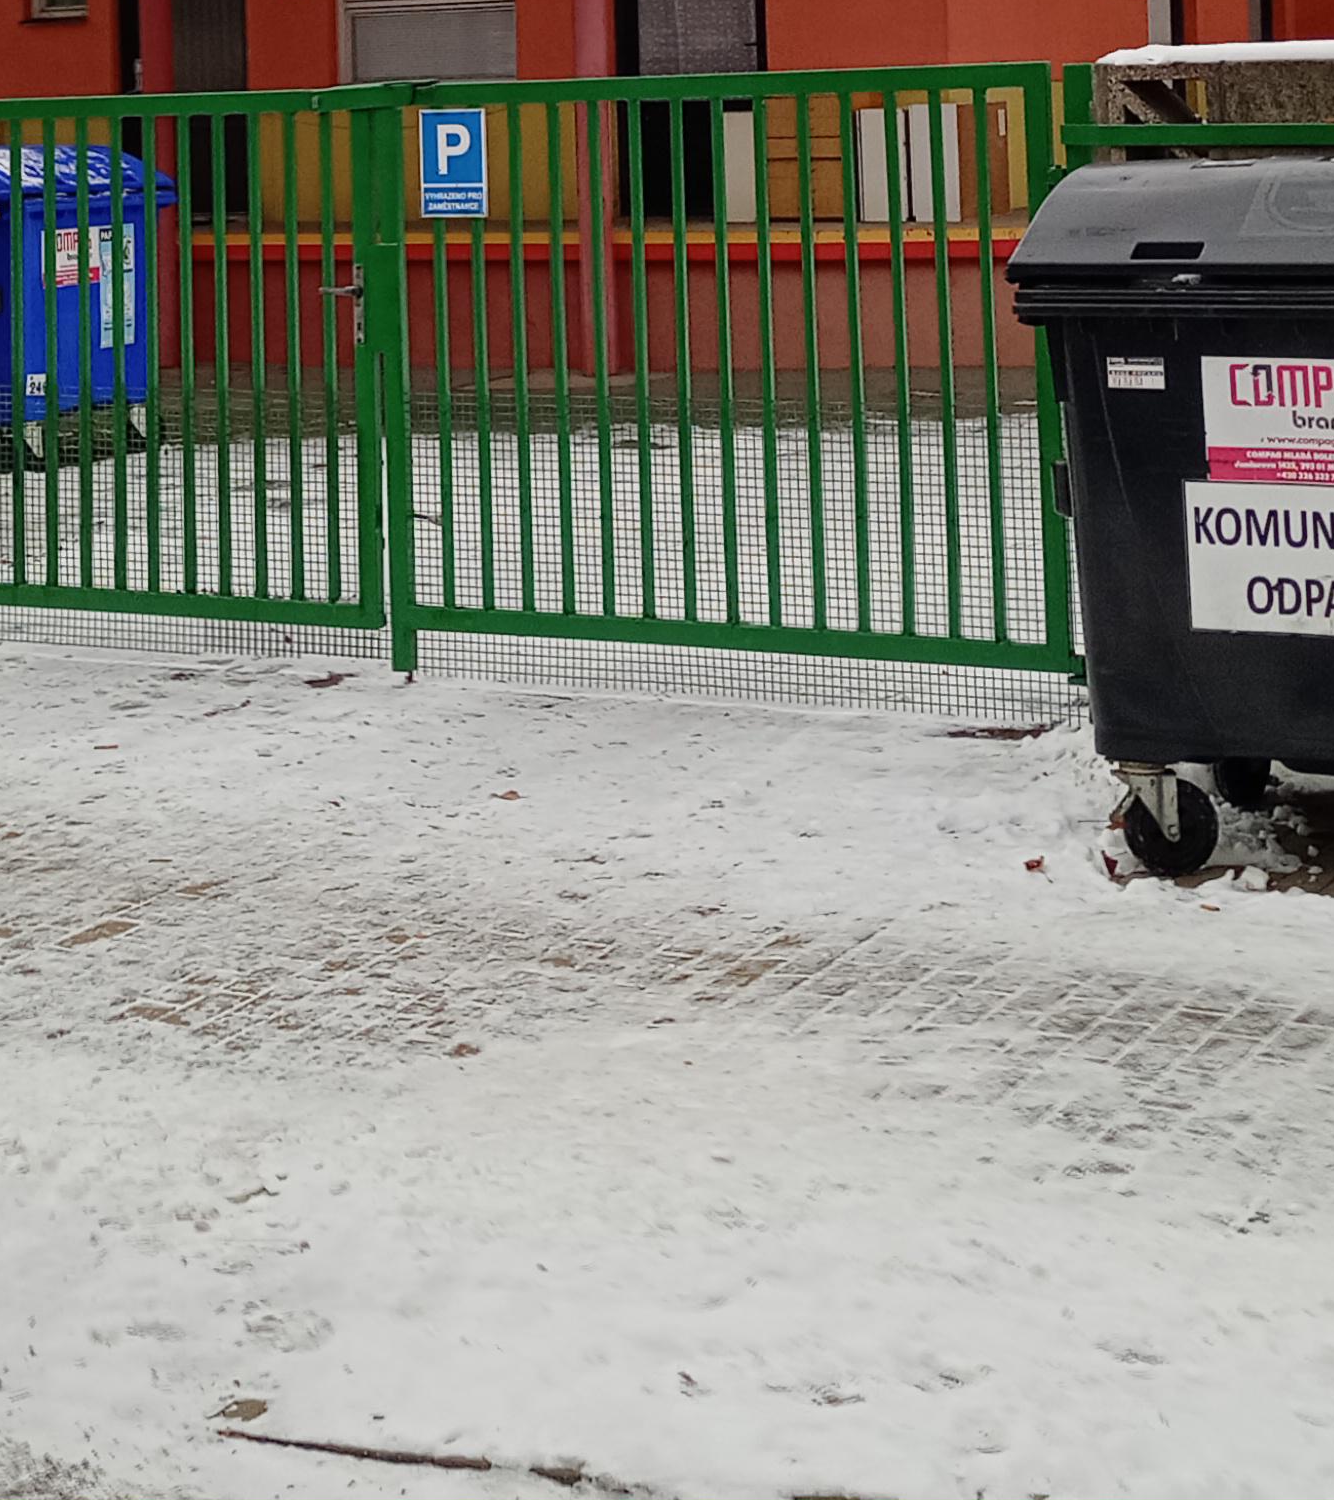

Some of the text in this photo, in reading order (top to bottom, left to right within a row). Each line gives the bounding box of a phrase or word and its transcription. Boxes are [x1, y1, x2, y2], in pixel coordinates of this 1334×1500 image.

[437, 123, 471, 175] P
[468, 191, 483, 199] PRO
[1246, 450, 1282, 460] COMPAG
[1283, 450, 1312, 460] MLADÁ
